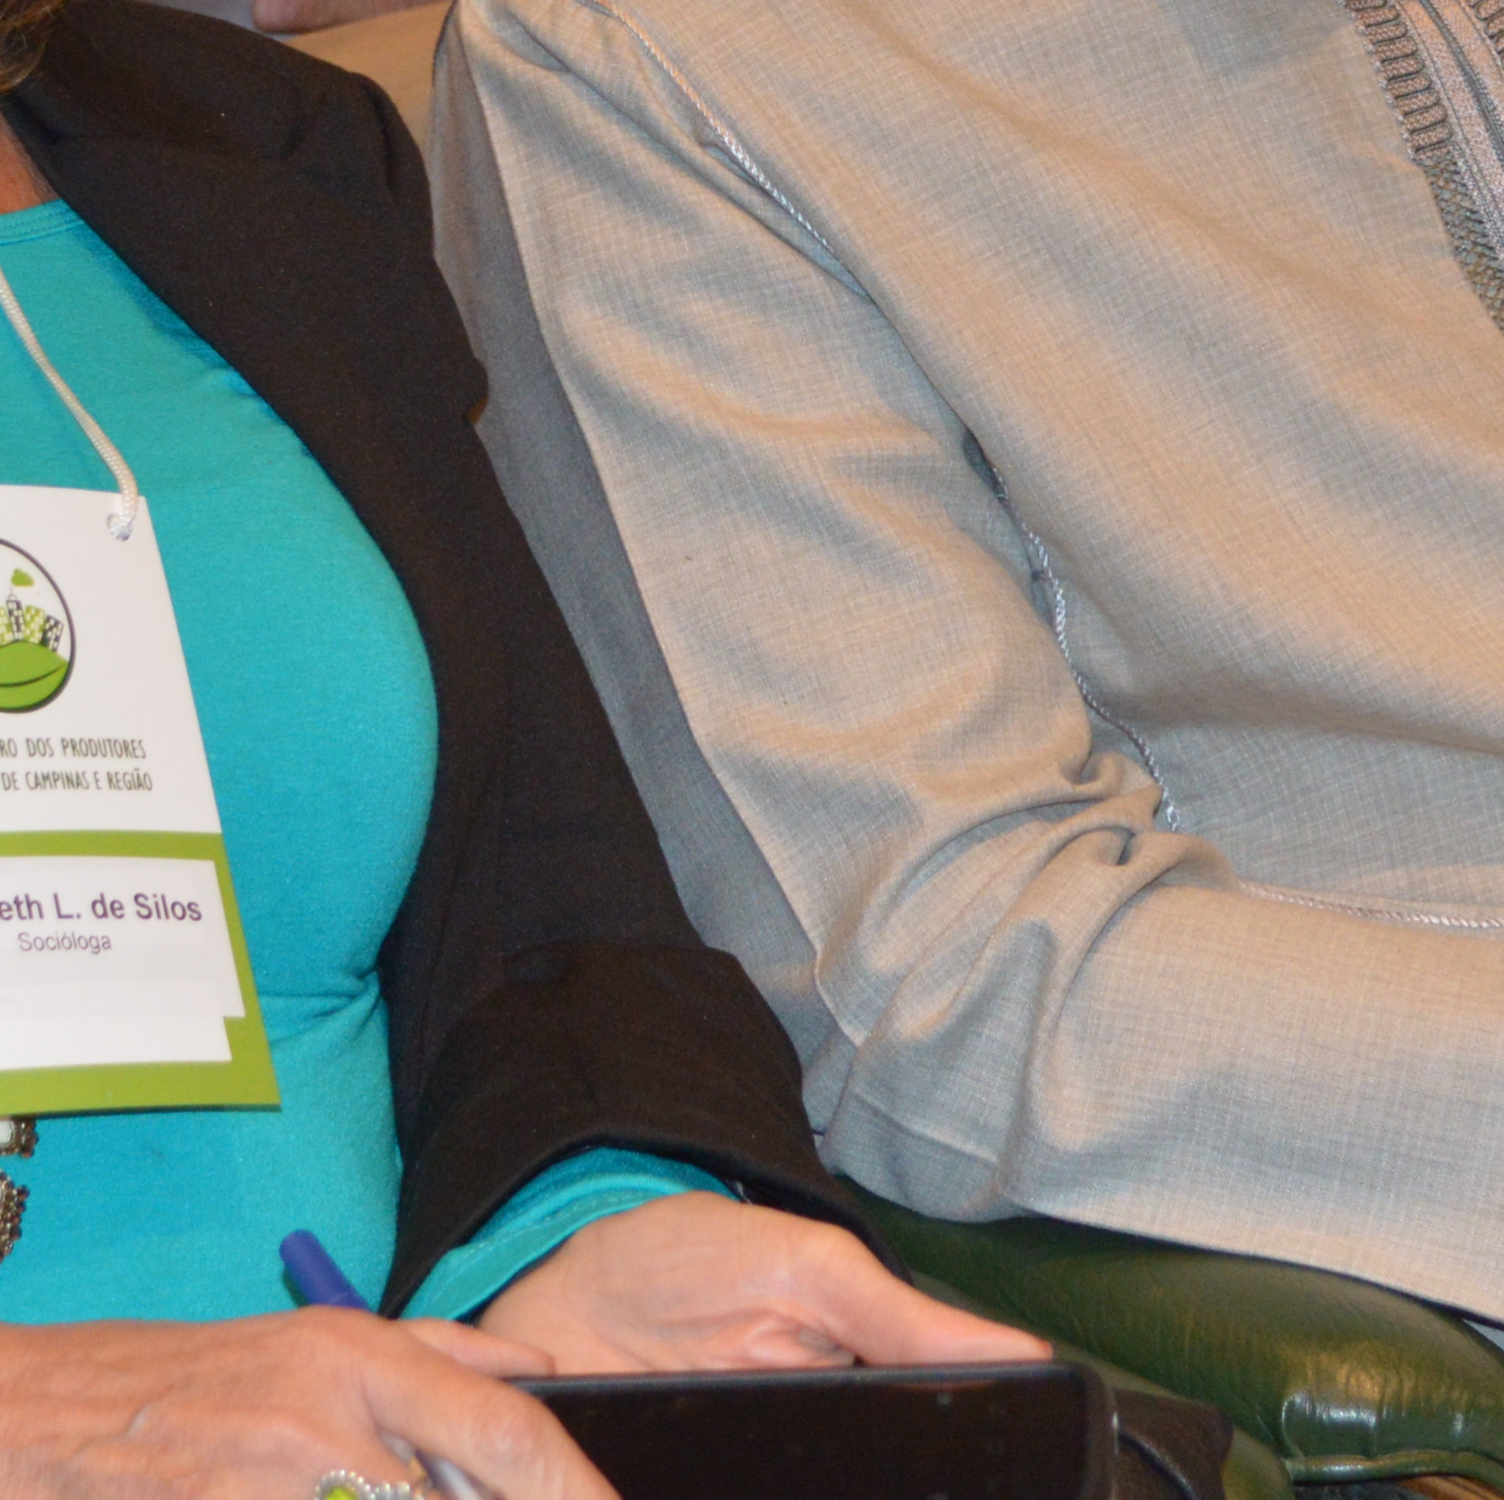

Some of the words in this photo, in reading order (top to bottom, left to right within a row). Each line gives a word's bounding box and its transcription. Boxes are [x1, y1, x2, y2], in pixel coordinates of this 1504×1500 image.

[25, 737, 55, 758] DOS
[61, 737, 147, 759] PRODUTORES
[1, 771, 21, 791] DE
[25, 771, 91, 791] CAMPINAS
[93, 771, 103, 790] E
[107, 768, 153, 791] REGIÃO
[53, 893, 82, 920] L.
[91, 893, 125, 920] de
[133, 892, 203, 922] Silos
[17, 932, 112, 955] Socióloga
